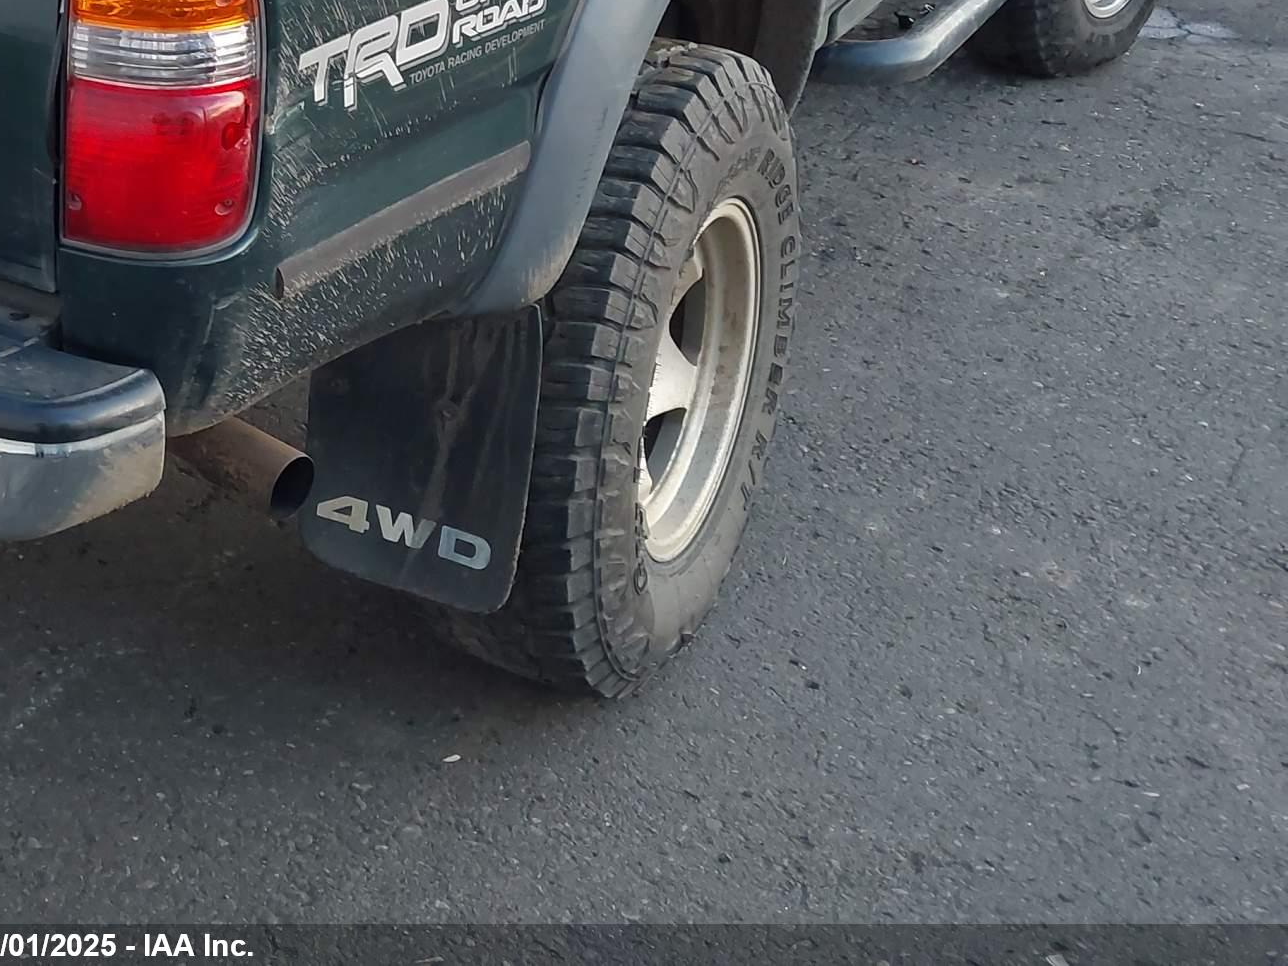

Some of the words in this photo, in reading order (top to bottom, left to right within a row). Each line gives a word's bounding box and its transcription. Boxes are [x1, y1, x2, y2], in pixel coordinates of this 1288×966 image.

[409, 60, 446, 86] TOYOTA
[447, 45, 483, 70] RACING
[484, 18, 547, 55] DEVELOPMENT
[757, 147, 794, 226] RIDGE
[761, 235, 797, 416] CLIMBER
[315, 495, 492, 570] 4WD
